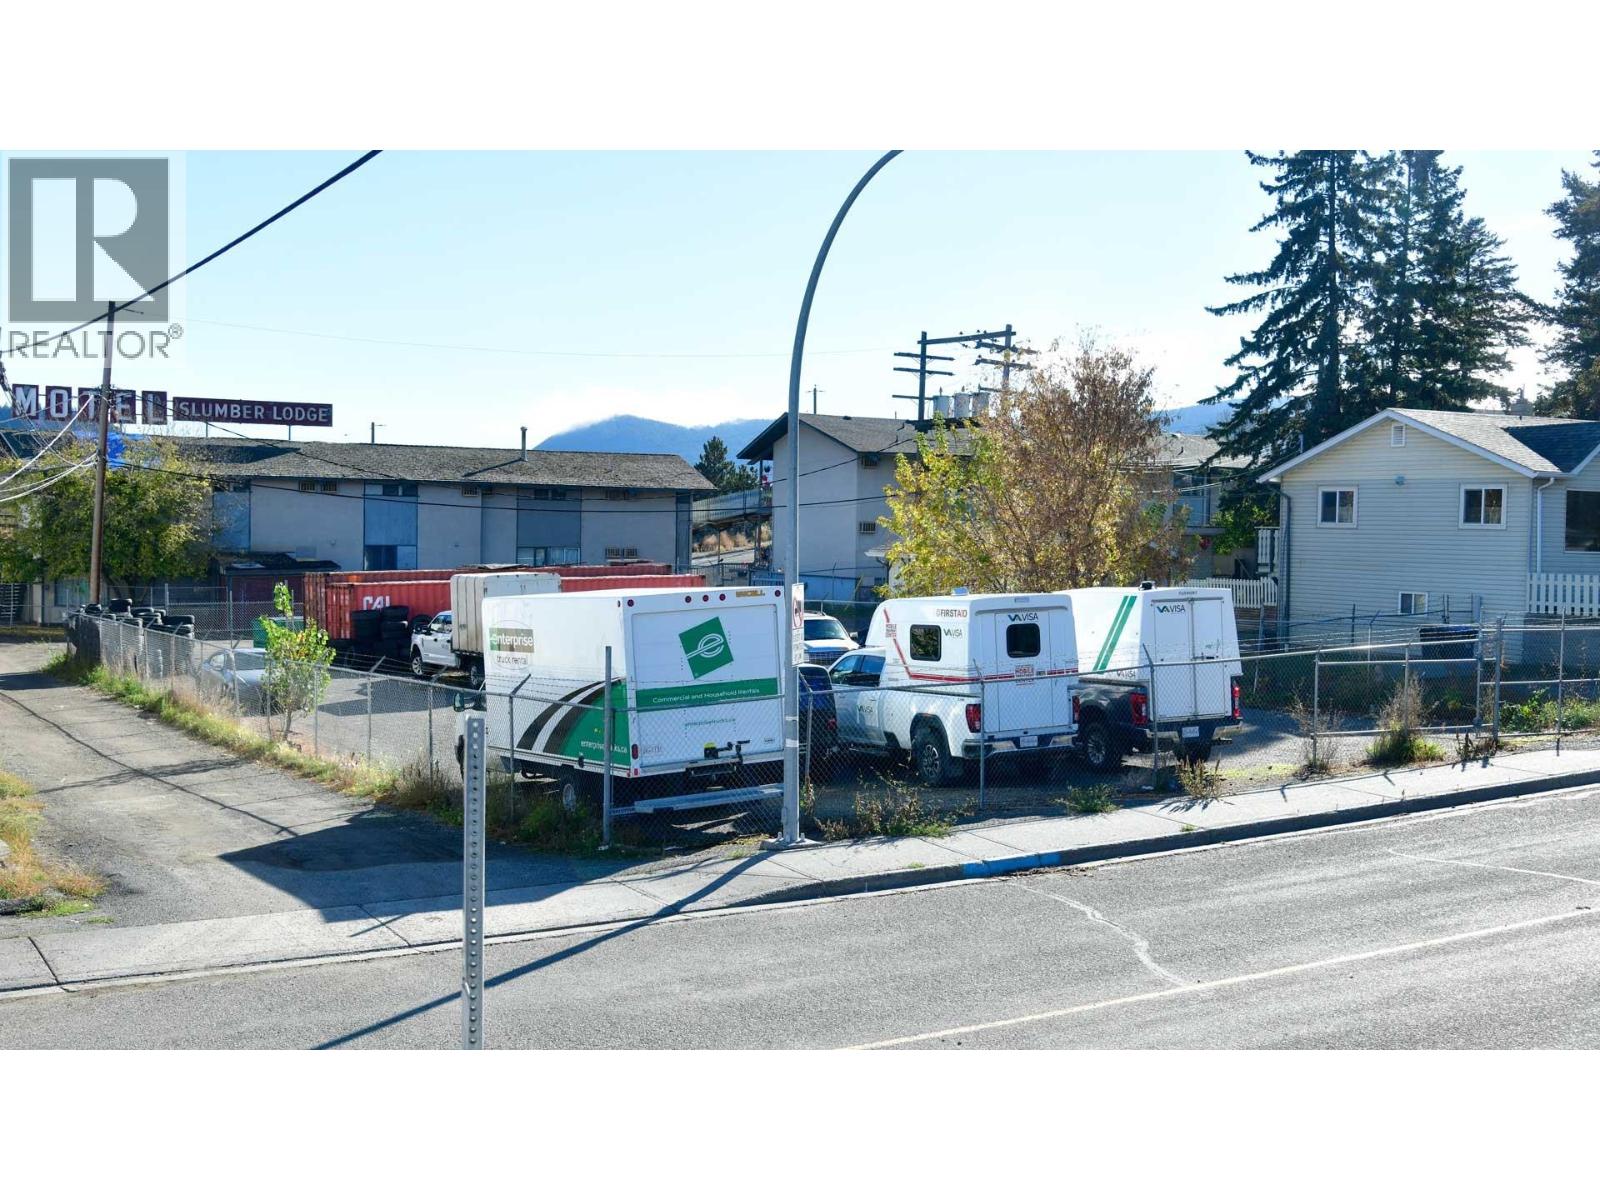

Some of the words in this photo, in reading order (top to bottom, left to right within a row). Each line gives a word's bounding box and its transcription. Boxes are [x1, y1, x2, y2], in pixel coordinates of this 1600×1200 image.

[14, 386, 162, 422] MOTEL
[179, 401, 264, 420] SLUMBER
[272, 406, 328, 422] LODGE
[490, 633, 534, 650] enterprise
[652, 694, 690, 704] Commercial
[704, 688, 737, 698] Household
